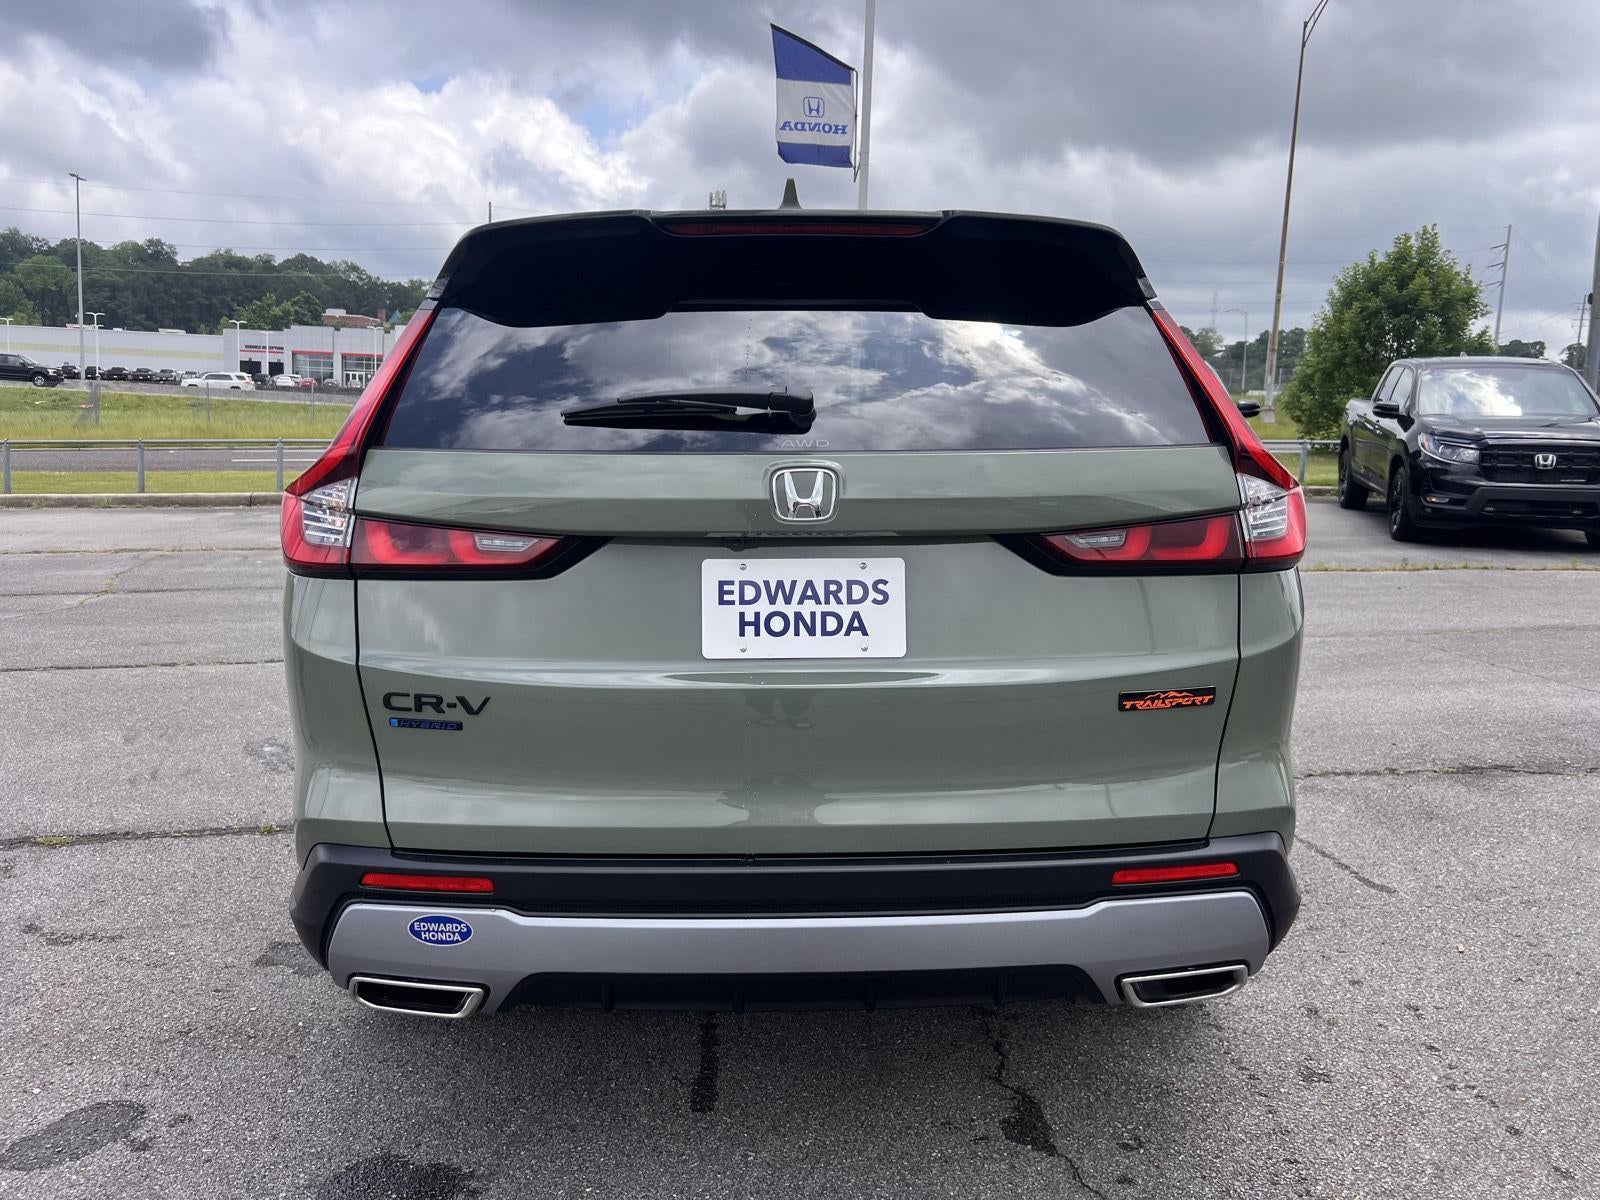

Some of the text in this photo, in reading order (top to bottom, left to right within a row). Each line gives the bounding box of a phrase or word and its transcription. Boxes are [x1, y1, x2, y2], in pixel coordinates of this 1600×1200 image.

[780, 439, 830, 448] AWD
[717, 579, 890, 606] EDWARDS
[738, 610, 869, 637] HONDA
[382, 692, 491, 715] CR-V
[1122, 695, 1214, 710] TRAILSPORT
[400, 719, 457, 730] HYBRID
[413, 922, 468, 932] EDWARDS
[421, 931, 462, 942] HONDA
